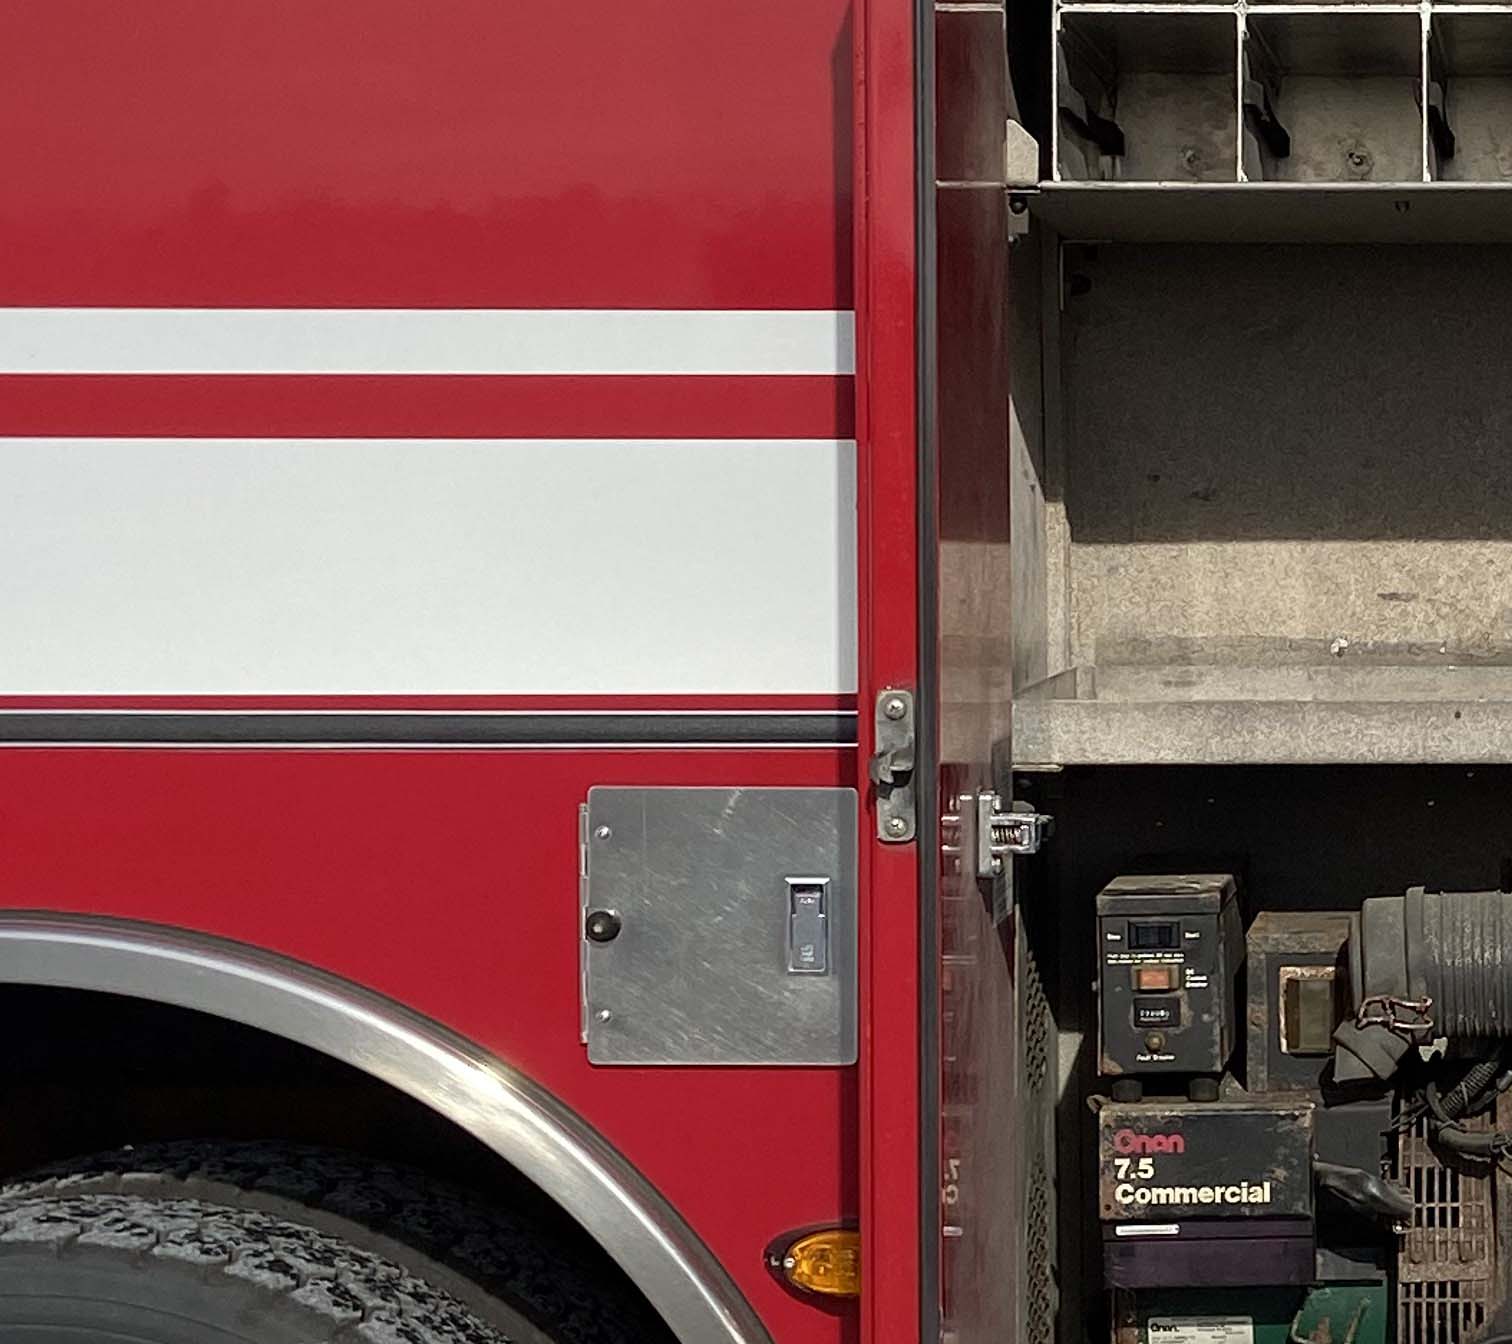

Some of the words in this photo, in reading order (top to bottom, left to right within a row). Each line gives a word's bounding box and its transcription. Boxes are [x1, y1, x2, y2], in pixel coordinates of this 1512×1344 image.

[1114, 1128, 1185, 1154] Onan
[1114, 1157, 1155, 1180] 7.5
[1114, 1181, 1271, 1205] Commercial
